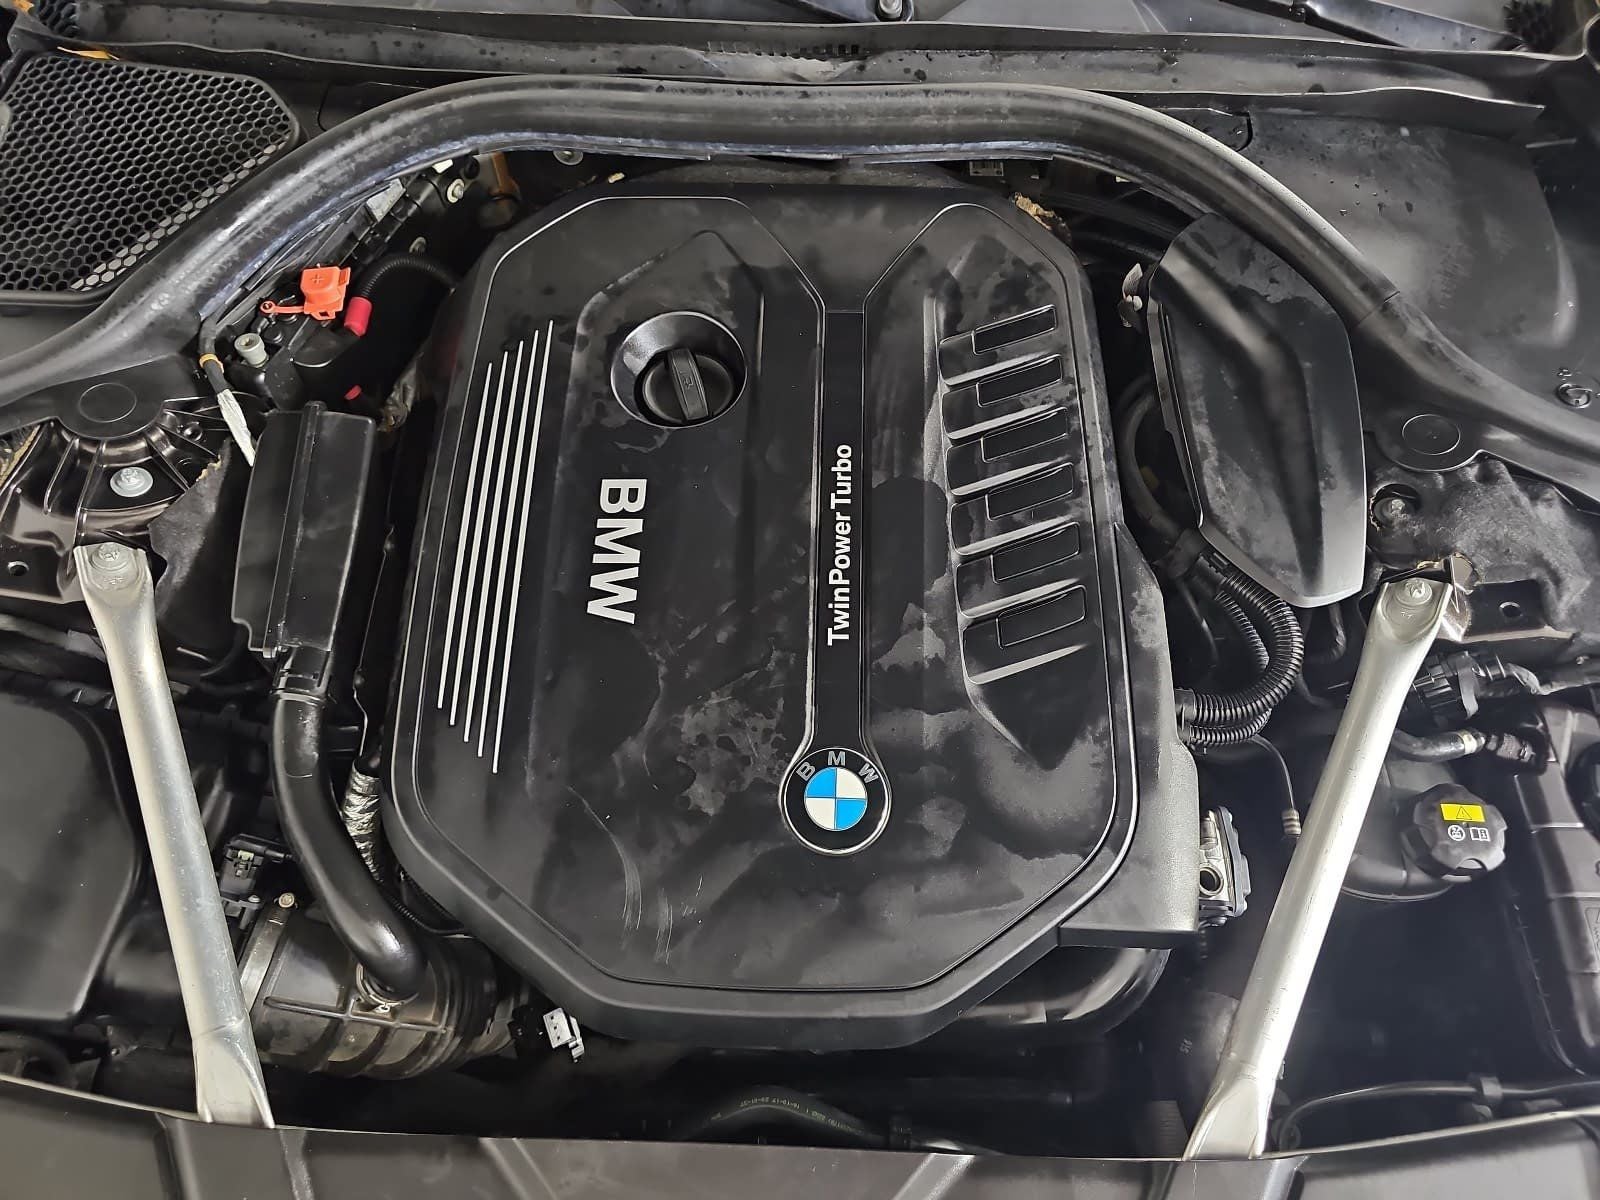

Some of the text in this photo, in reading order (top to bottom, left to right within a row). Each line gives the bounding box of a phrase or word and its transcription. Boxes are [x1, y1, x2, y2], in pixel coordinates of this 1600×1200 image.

[586, 478, 648, 625] BMW
[827, 444, 853, 646] TwinPower Turbo
[795, 750, 879, 784] BMW
